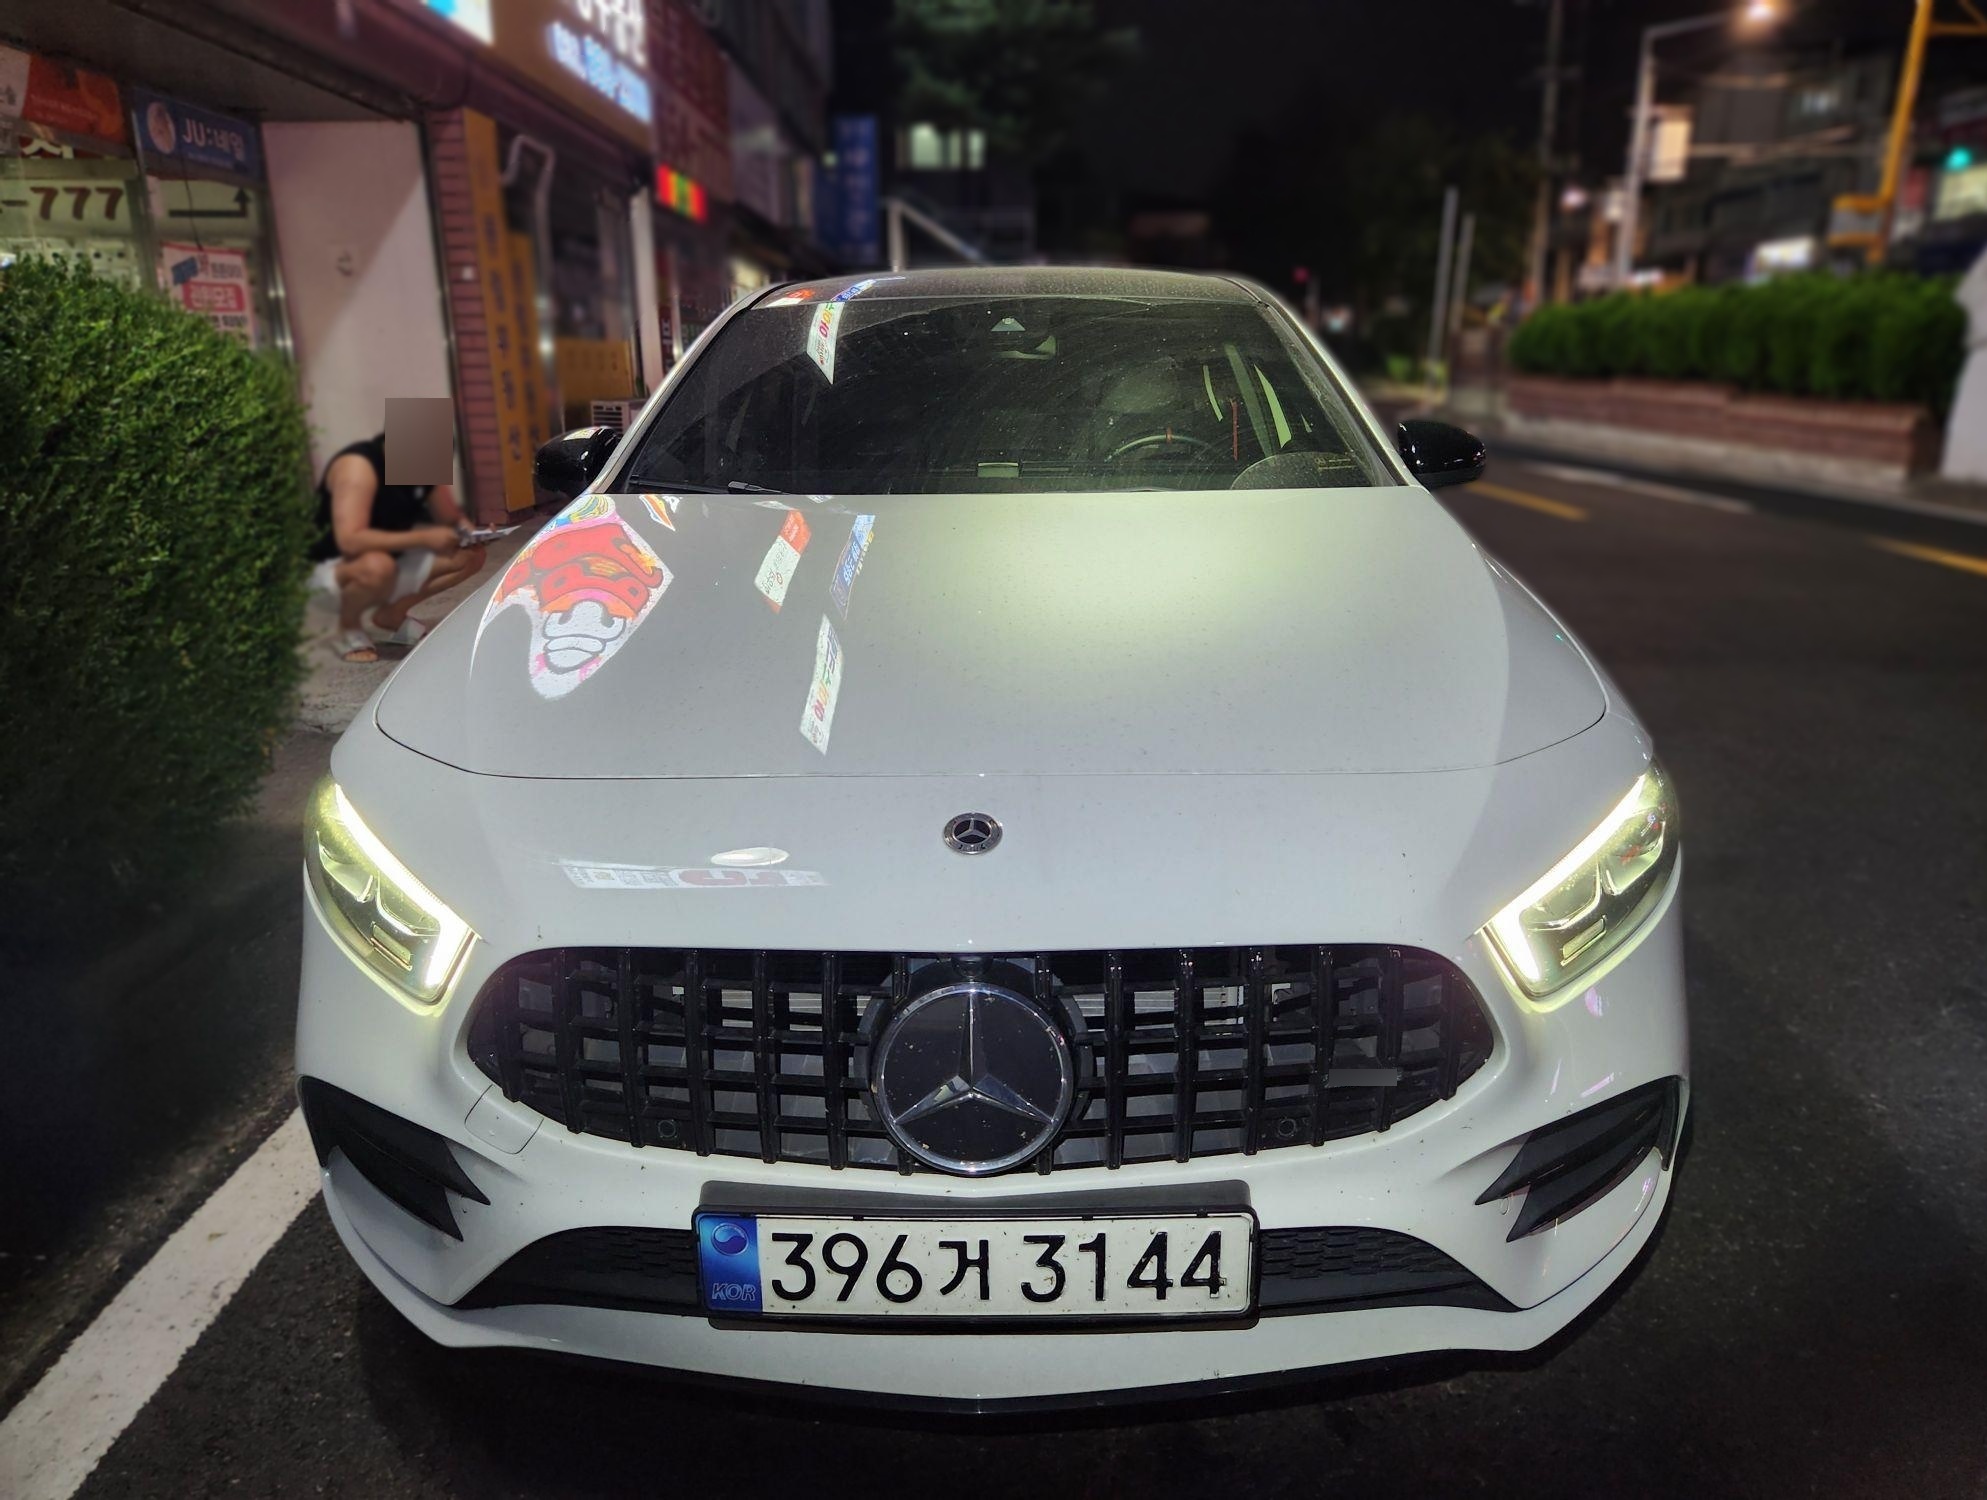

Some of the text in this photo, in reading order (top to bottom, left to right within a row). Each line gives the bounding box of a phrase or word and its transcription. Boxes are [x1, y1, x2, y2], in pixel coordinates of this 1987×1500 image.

[771, 1231, 1228, 1302] 396거 3144
[711, 1282, 756, 1301] KOR
